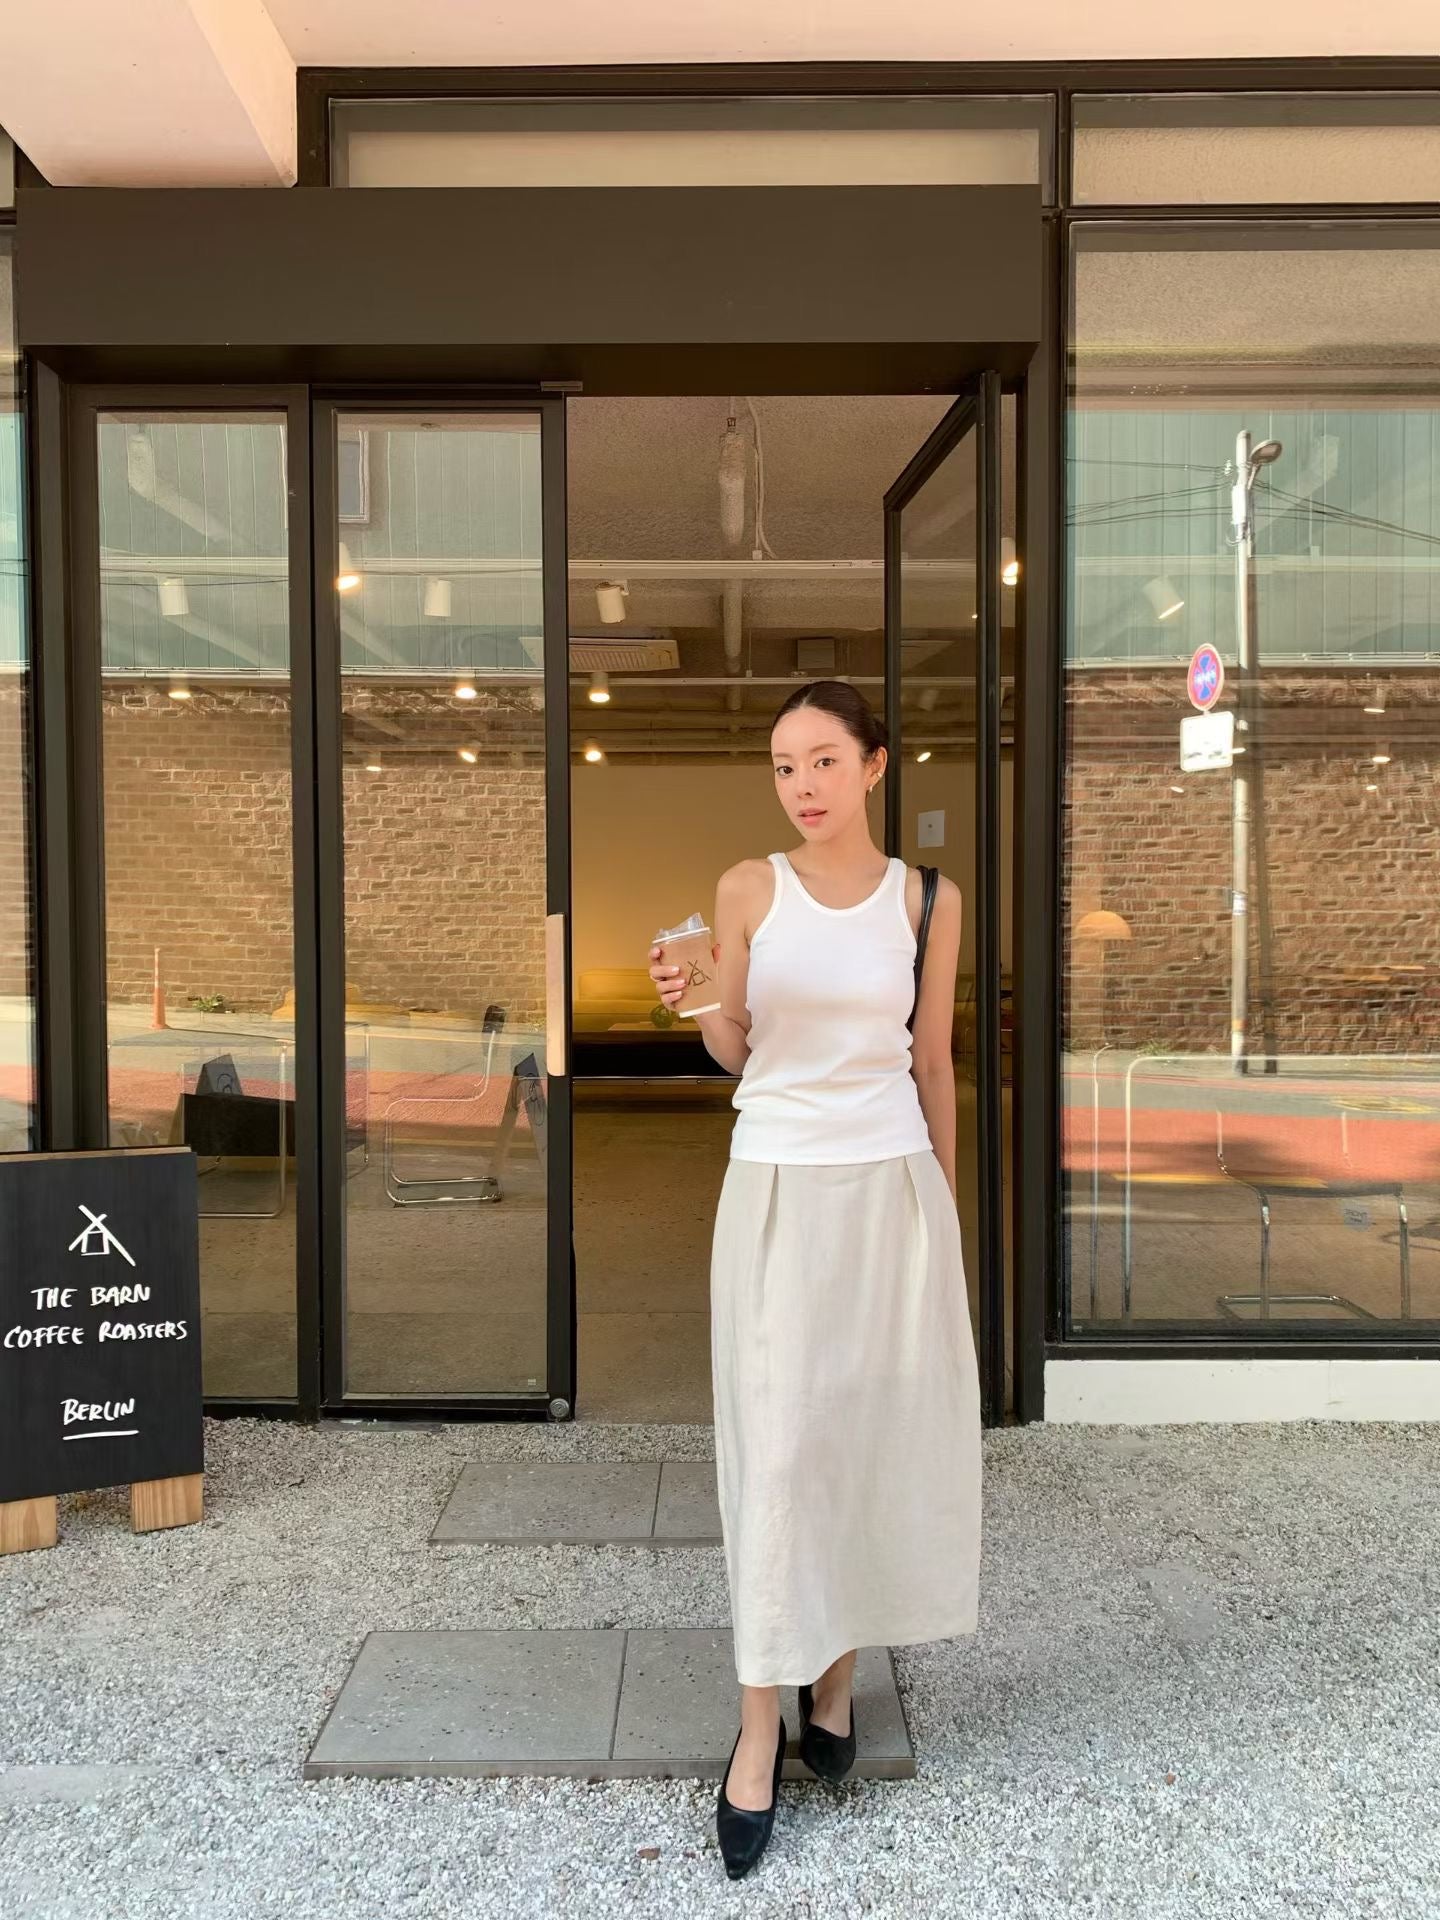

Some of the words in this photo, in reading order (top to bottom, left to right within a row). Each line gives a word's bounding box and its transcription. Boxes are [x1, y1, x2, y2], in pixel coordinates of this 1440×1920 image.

[30, 1286, 78, 1311] THE
[90, 1283, 151, 1307] BARN
[4, 1325, 85, 1349] COFFEE
[99, 1320, 188, 1343] ROASTERS
[60, 1398, 136, 1426] BERLIN
